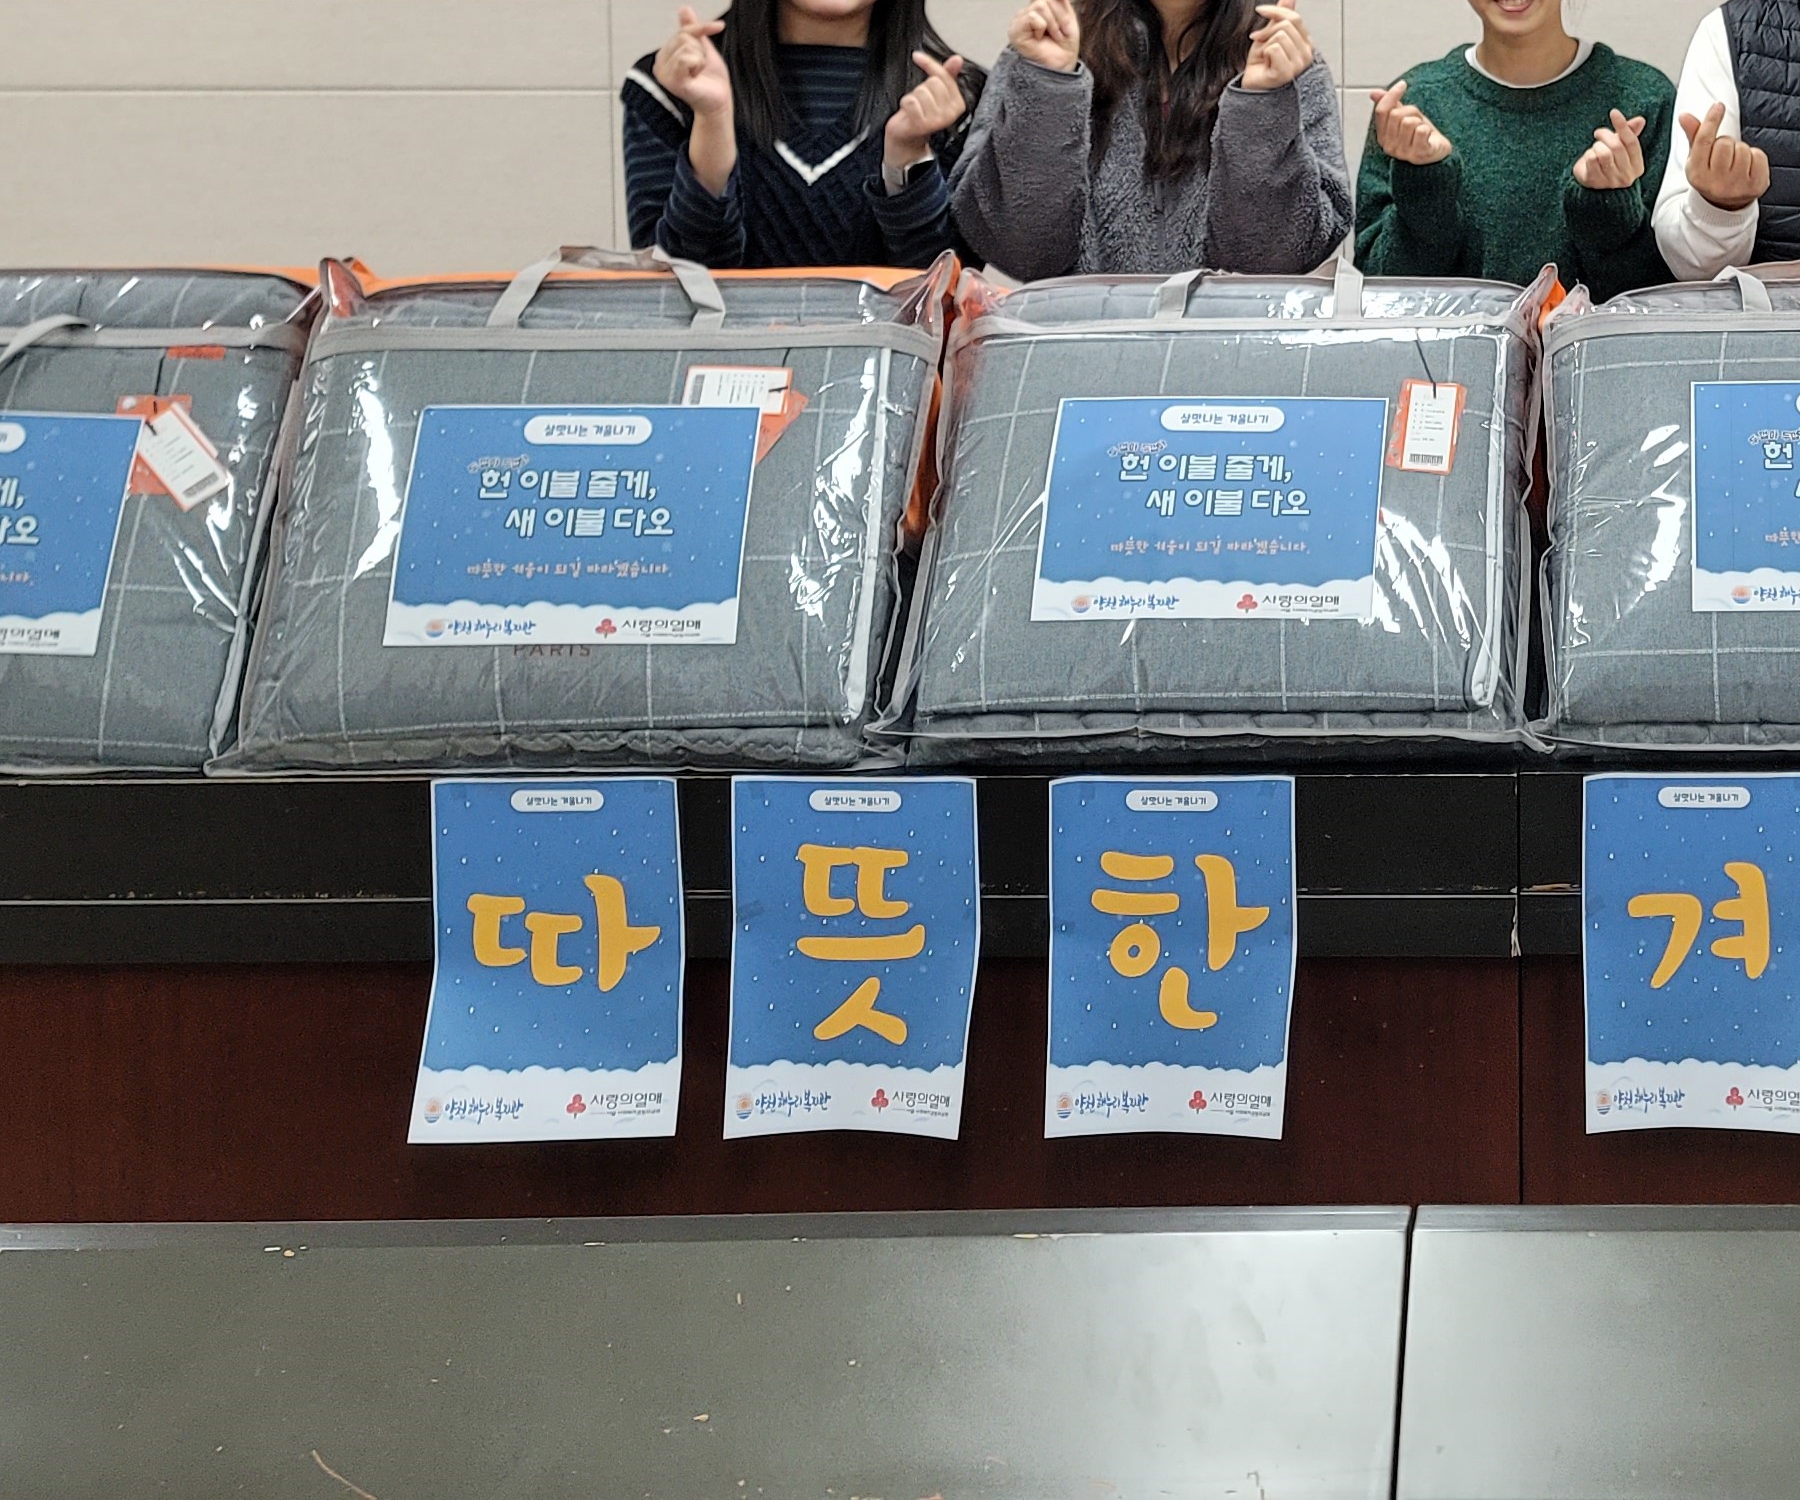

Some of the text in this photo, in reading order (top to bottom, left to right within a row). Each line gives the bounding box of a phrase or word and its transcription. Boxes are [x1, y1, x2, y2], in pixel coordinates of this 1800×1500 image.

[1180, 413, 1269, 425] 살맛나는 겨울나기
[1120, 455, 1293, 484] 헌 이불 줄게,
[1763, 441, 1793, 470] 헌
[480, 469, 657, 500] 헌 이불 줄게,
[1146, 490, 1310, 517] 새 이불 다오
[505, 507, 674, 538] 새 이불 다오
[1263, 595, 1340, 610] 사랑의열매
[513, 643, 591, 657] PARIS
[467, 874, 661, 992] 따
[1627, 861, 1771, 989] 겨
[797, 844, 925, 1045] 뜻
[1091, 851, 1270, 1030] 한
[892, 1091, 951, 1109] 사랑의열매
[1210, 1092, 1272, 1109] 사랑의열매
